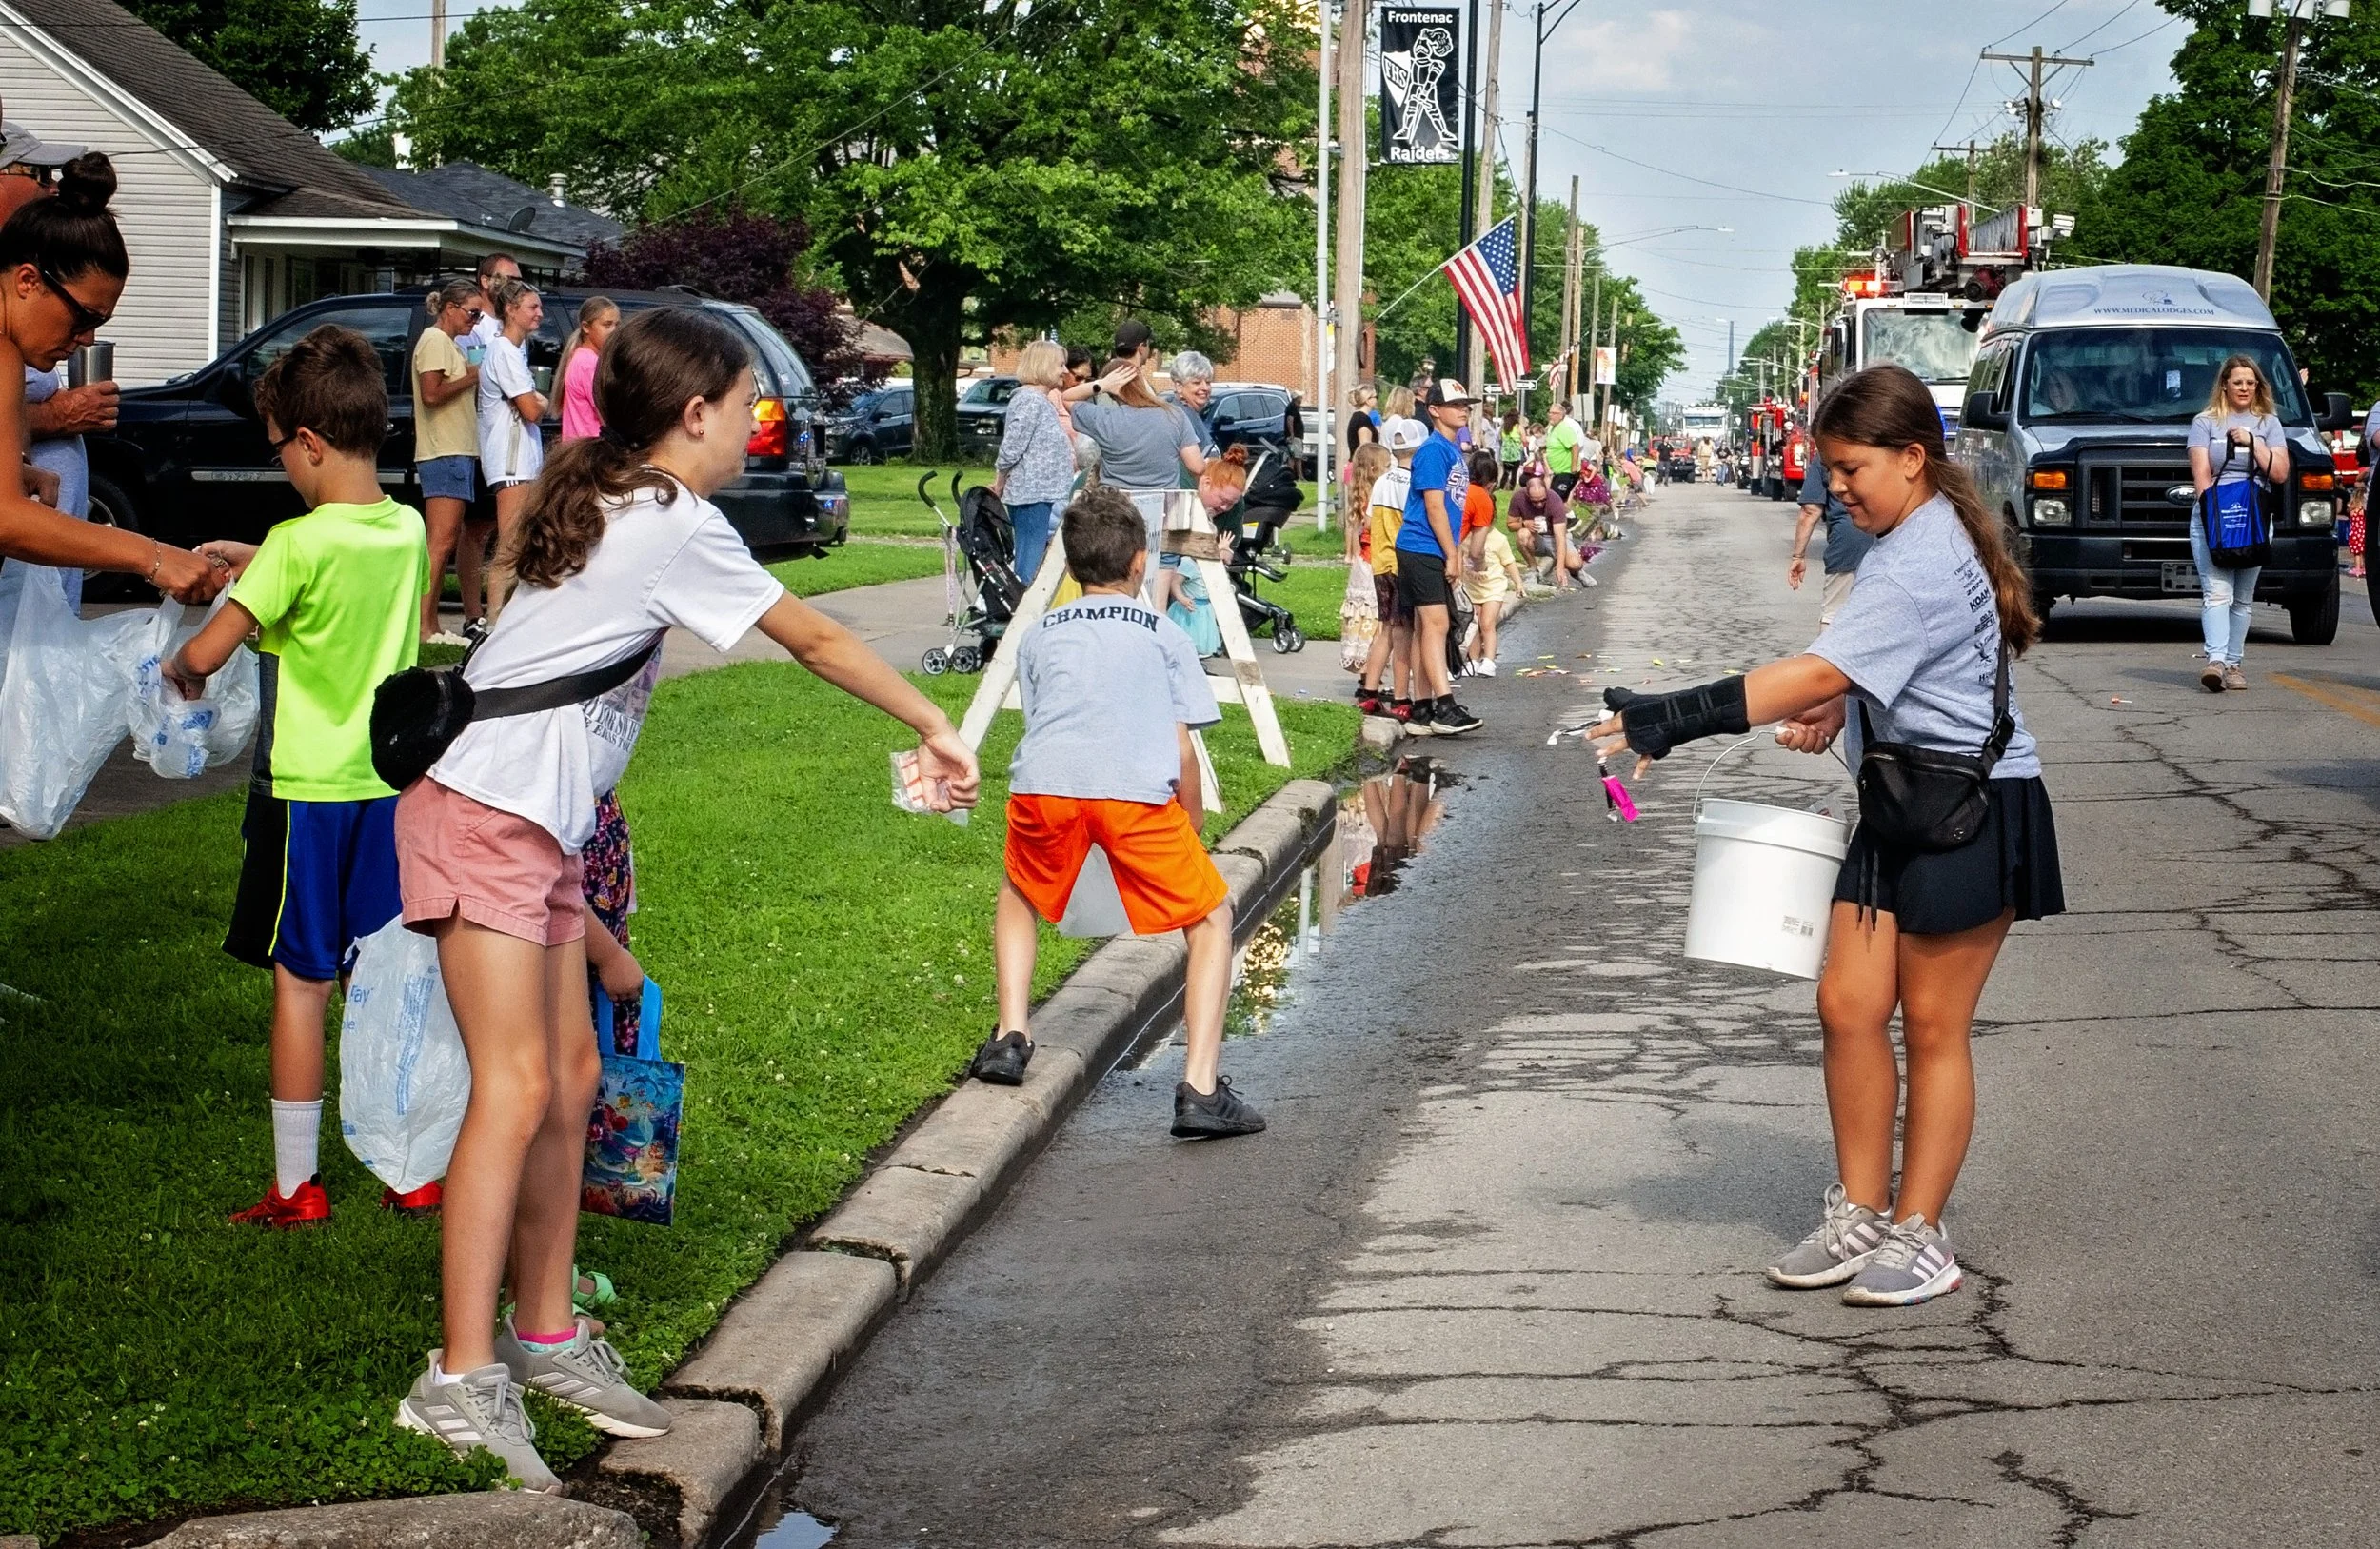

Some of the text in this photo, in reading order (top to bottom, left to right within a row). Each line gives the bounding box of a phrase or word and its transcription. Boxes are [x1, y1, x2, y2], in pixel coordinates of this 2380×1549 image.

[1388, 10, 1453, 24] Frontenac
[1385, 61, 1407, 89] FHS
[1390, 146, 1450, 161] Raiders
[2093, 307, 2214, 315] WWW.MEDICALODGES.COM
[1042, 606, 1160, 633] CHAMPION
